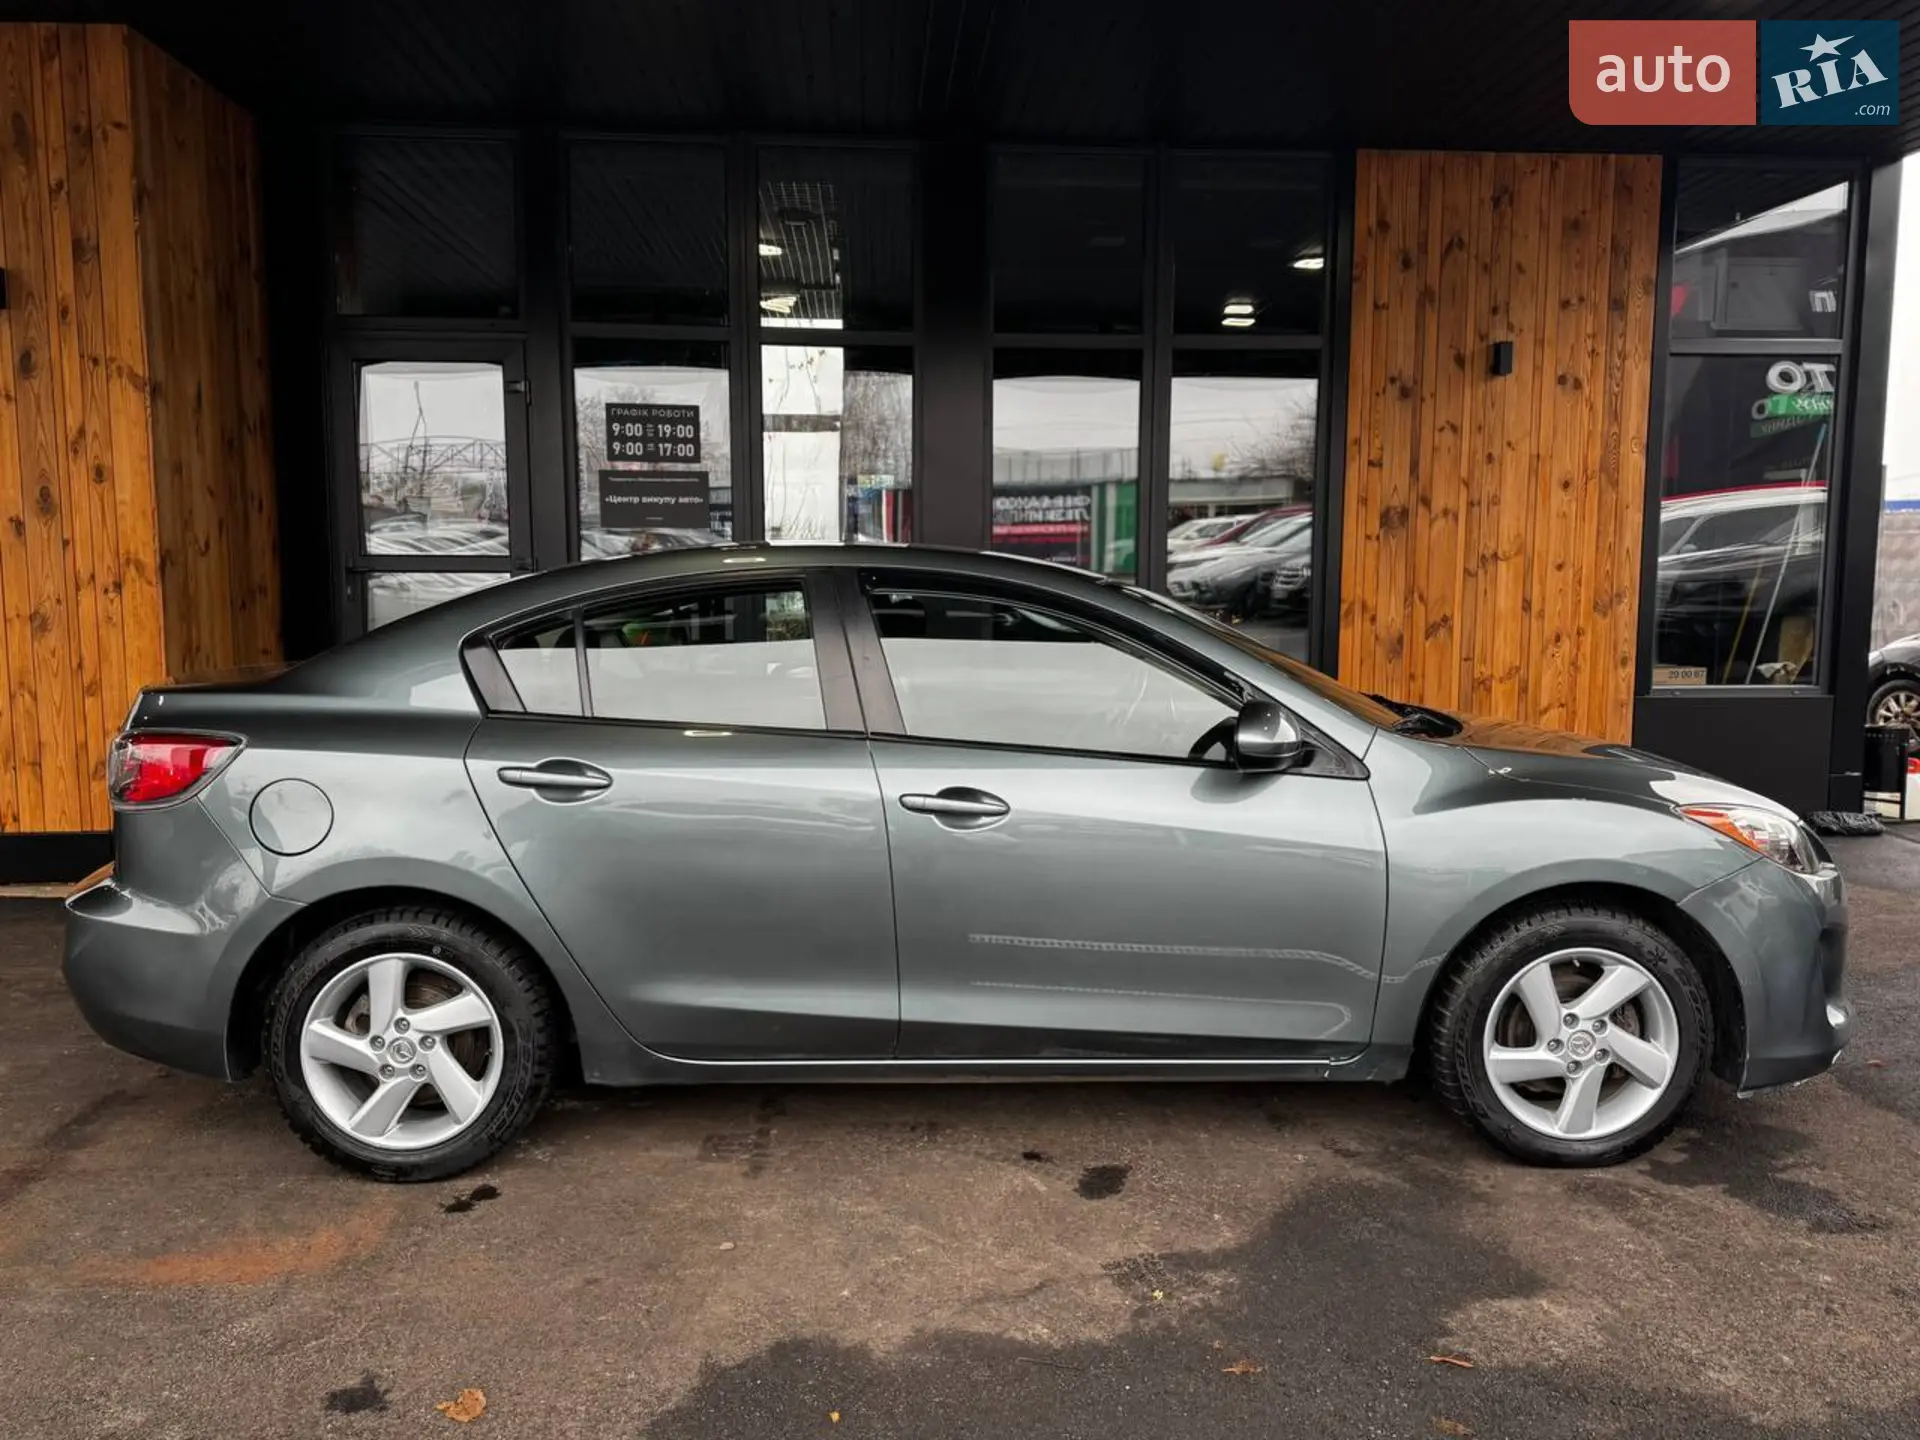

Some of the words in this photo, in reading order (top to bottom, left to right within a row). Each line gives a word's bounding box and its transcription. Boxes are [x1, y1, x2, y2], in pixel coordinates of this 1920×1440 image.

[611, 407, 648, 417] ГРАФІК
[651, 408, 694, 418] РОБОТИ
[611, 423, 643, 437] 9:00
[657, 424, 694, 438] 19:00
[612, 442, 643, 456] 9:00
[658, 443, 695, 457] 17:00
